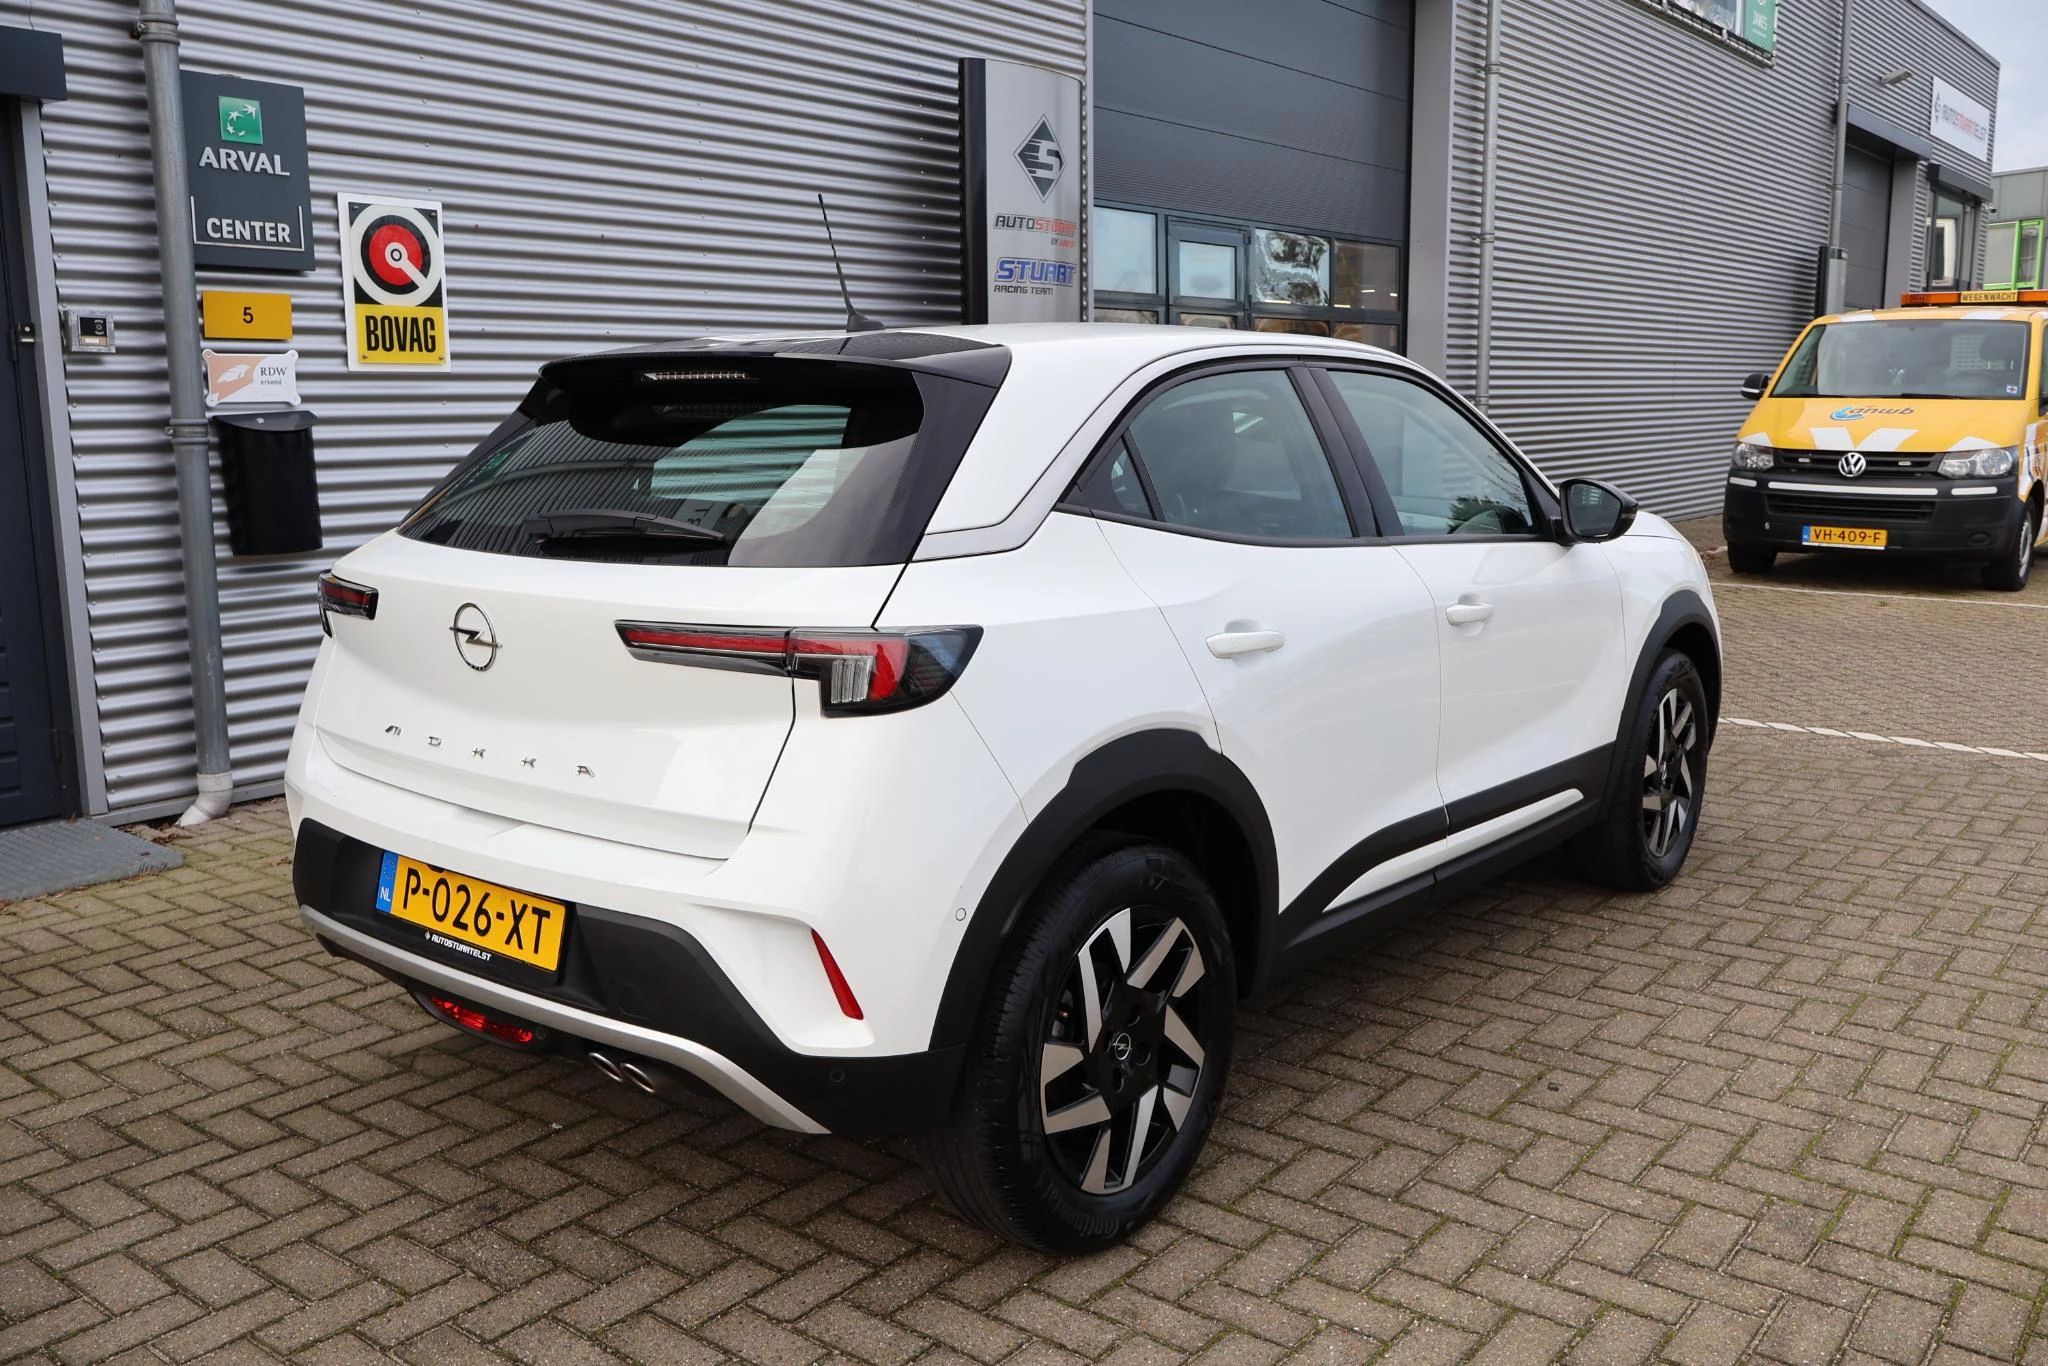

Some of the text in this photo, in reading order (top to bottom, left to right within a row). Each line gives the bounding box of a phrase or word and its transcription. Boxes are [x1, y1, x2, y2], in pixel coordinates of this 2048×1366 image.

[199, 146, 291, 177] ARVAL
[206, 217, 291, 243] CENTER
[996, 258, 1077, 286] STUART
[993, 285, 1054, 296] RACING TEAM
[1962, 291, 2017, 302] WEGENWACHT
[242, 306, 254, 324] 5
[365, 315, 437, 353] BOVAG
[260, 367, 287, 376] RDW
[260, 378, 282, 386] erkend
[1813, 528, 1882, 544] VH-409-F
[379, 886, 391, 903] NL
[402, 867, 552, 955] P-026-XT
